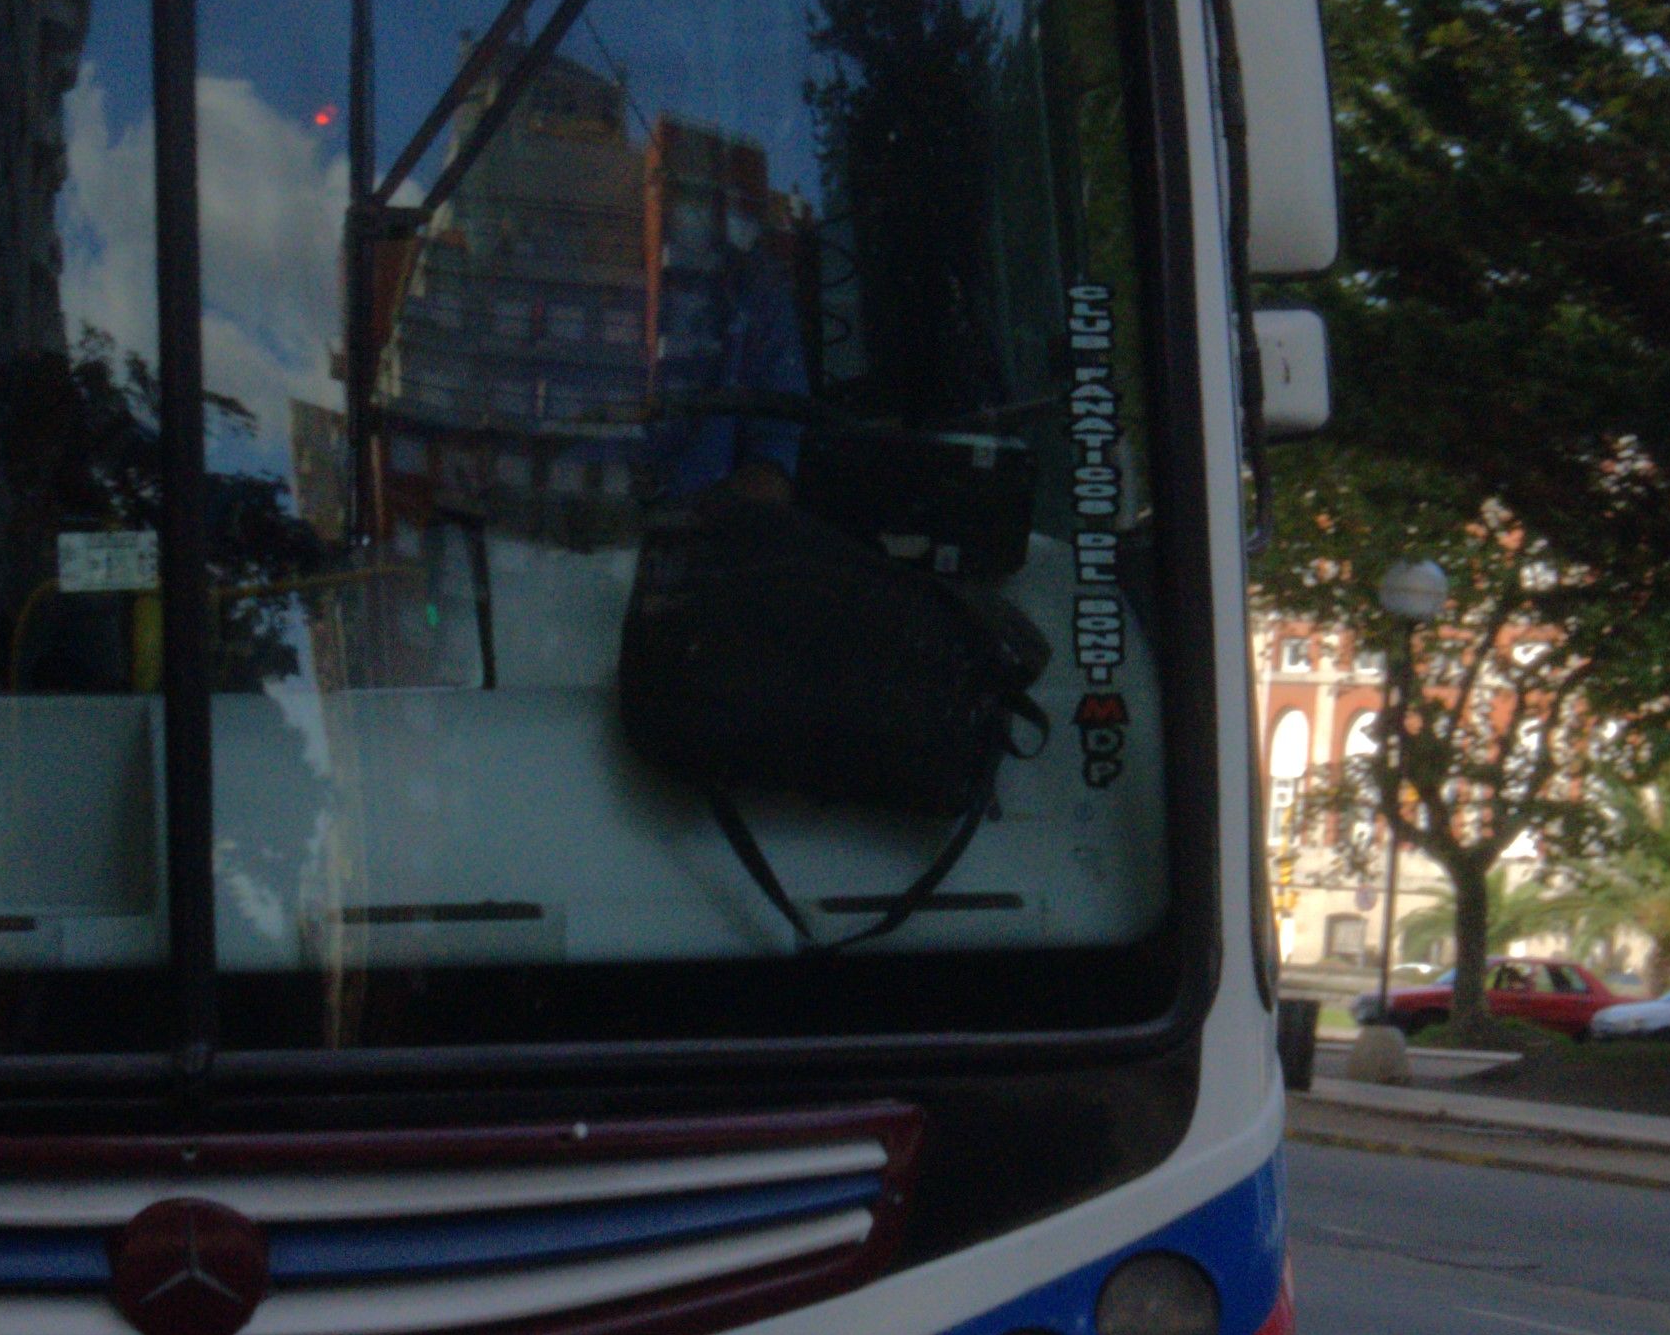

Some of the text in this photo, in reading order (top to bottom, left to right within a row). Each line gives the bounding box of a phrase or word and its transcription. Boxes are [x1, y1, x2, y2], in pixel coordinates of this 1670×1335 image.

[1068, 366, 1119, 515] FANATICOS
[1076, 531, 1118, 582] DEL
[1076, 598, 1122, 682] BONDI
